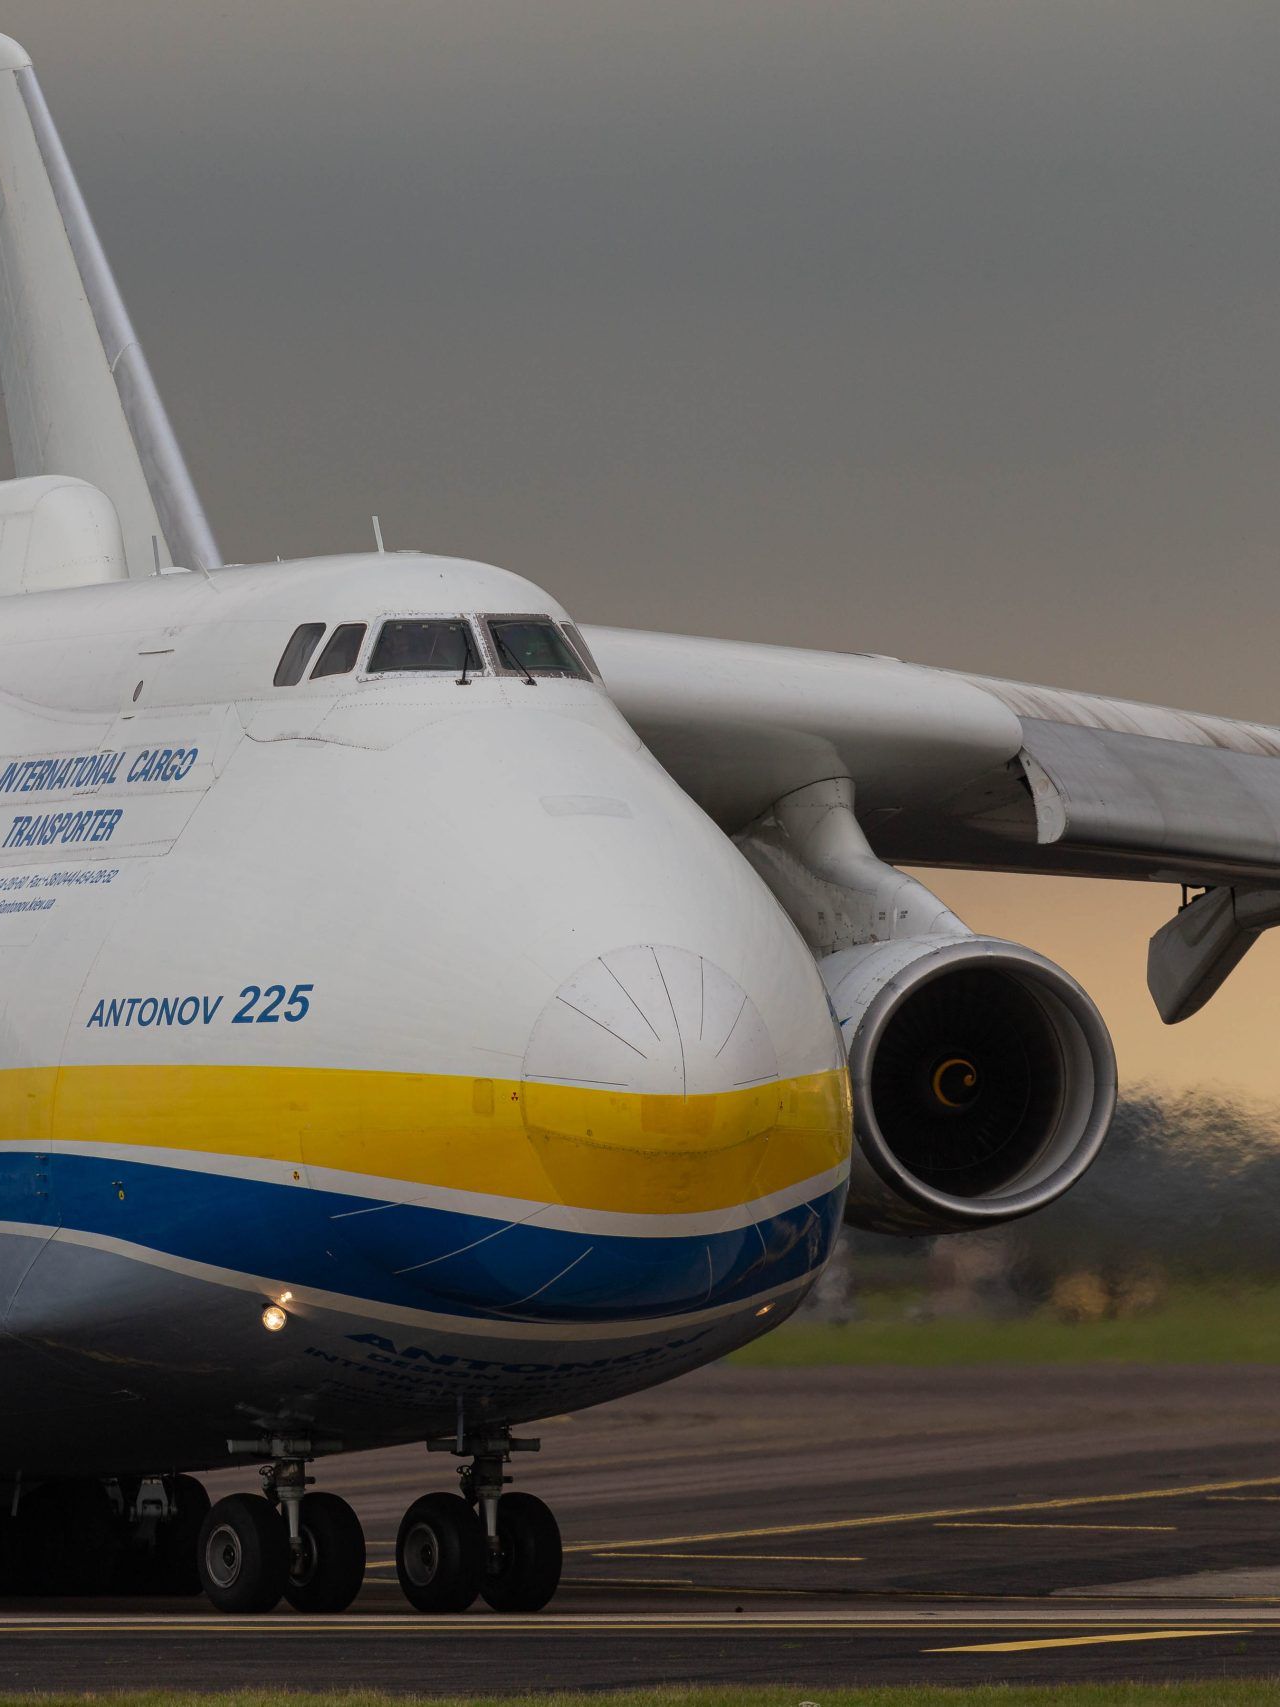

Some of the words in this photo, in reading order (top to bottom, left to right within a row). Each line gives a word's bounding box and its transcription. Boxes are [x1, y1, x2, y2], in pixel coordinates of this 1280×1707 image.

[126, 748, 199, 784] CARGO
[2, 808, 124, 848] TRANSPORTER
[86, 995, 224, 1028] ANTONOV
[231, 983, 314, 1024] 225
[343, 1325, 717, 1375] ANTONOV
